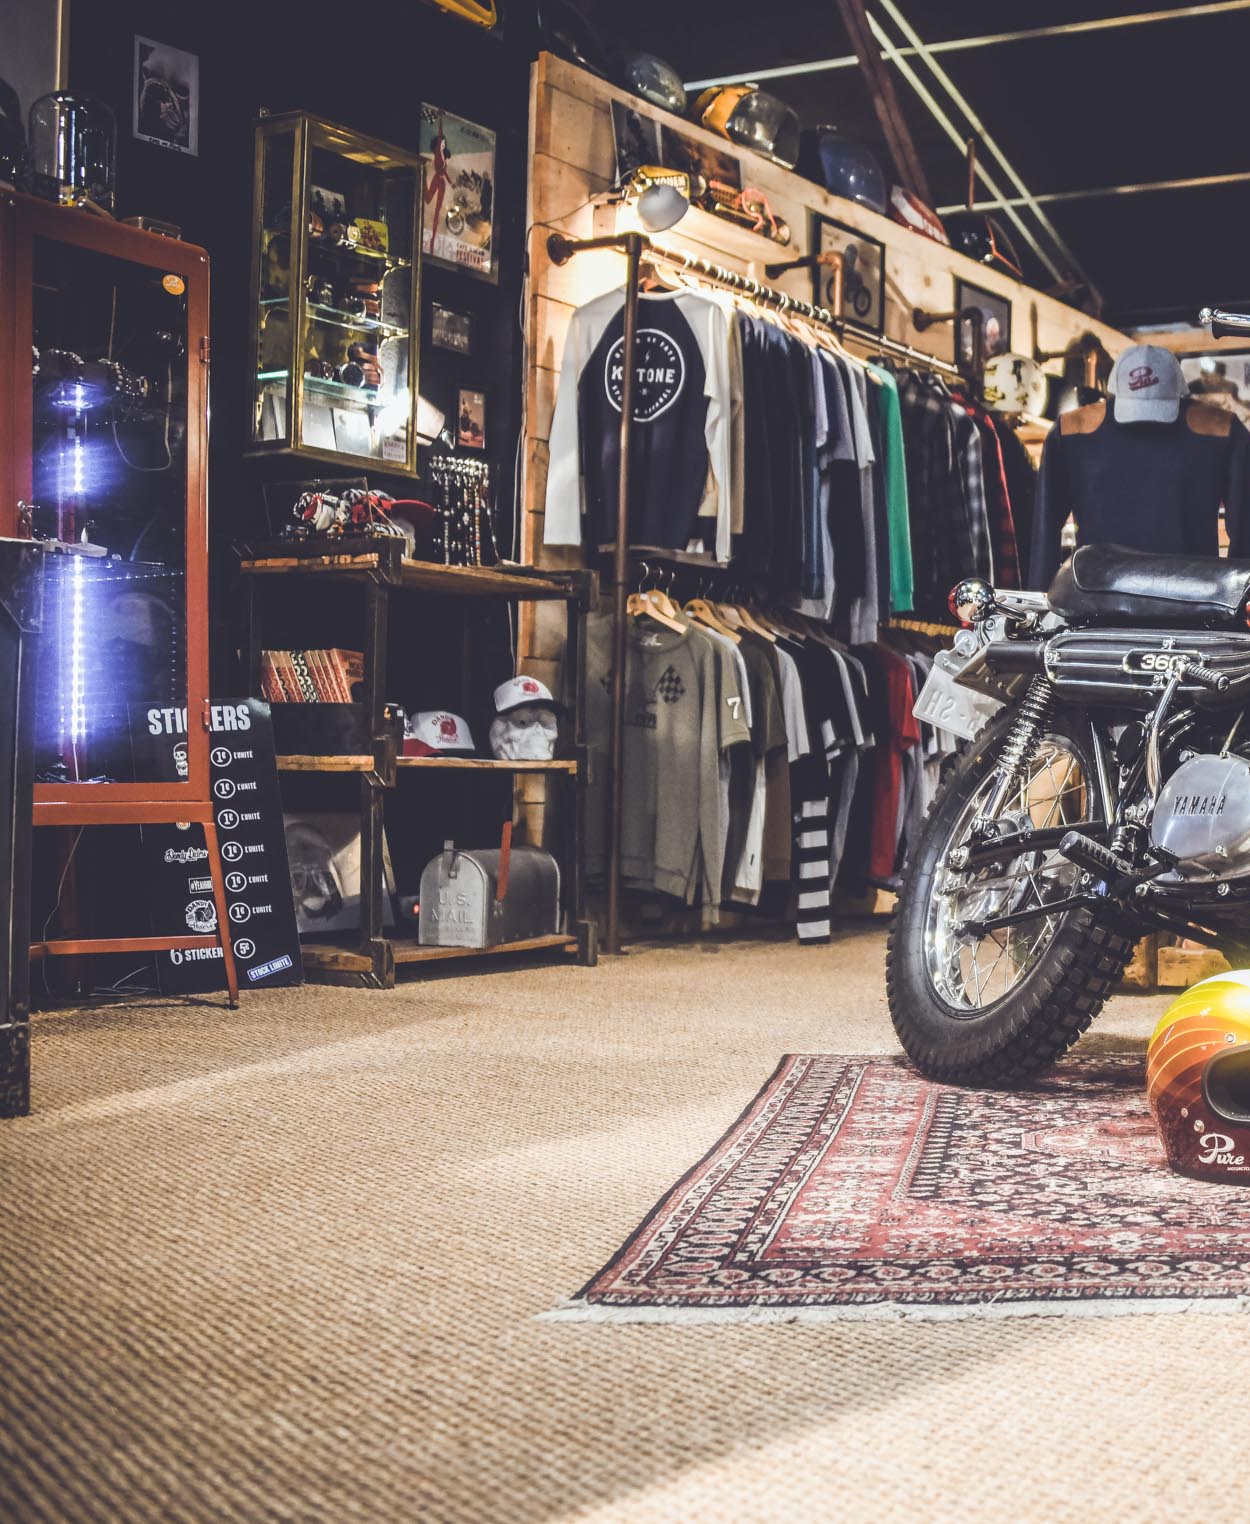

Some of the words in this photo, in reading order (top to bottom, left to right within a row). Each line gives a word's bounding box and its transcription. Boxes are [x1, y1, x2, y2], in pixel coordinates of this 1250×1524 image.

[611, 365, 676, 384] KTONE
[726, 696, 741, 720] 7
[147, 704, 251, 735] STIERS
[1173, 795, 1226, 816] YAMAHA
[432, 908, 475, 924] MAIL
[170, 948, 184, 965] 6
[250, 965, 271, 979] STOCK
[1198, 1133, 1245, 1165] Pure
